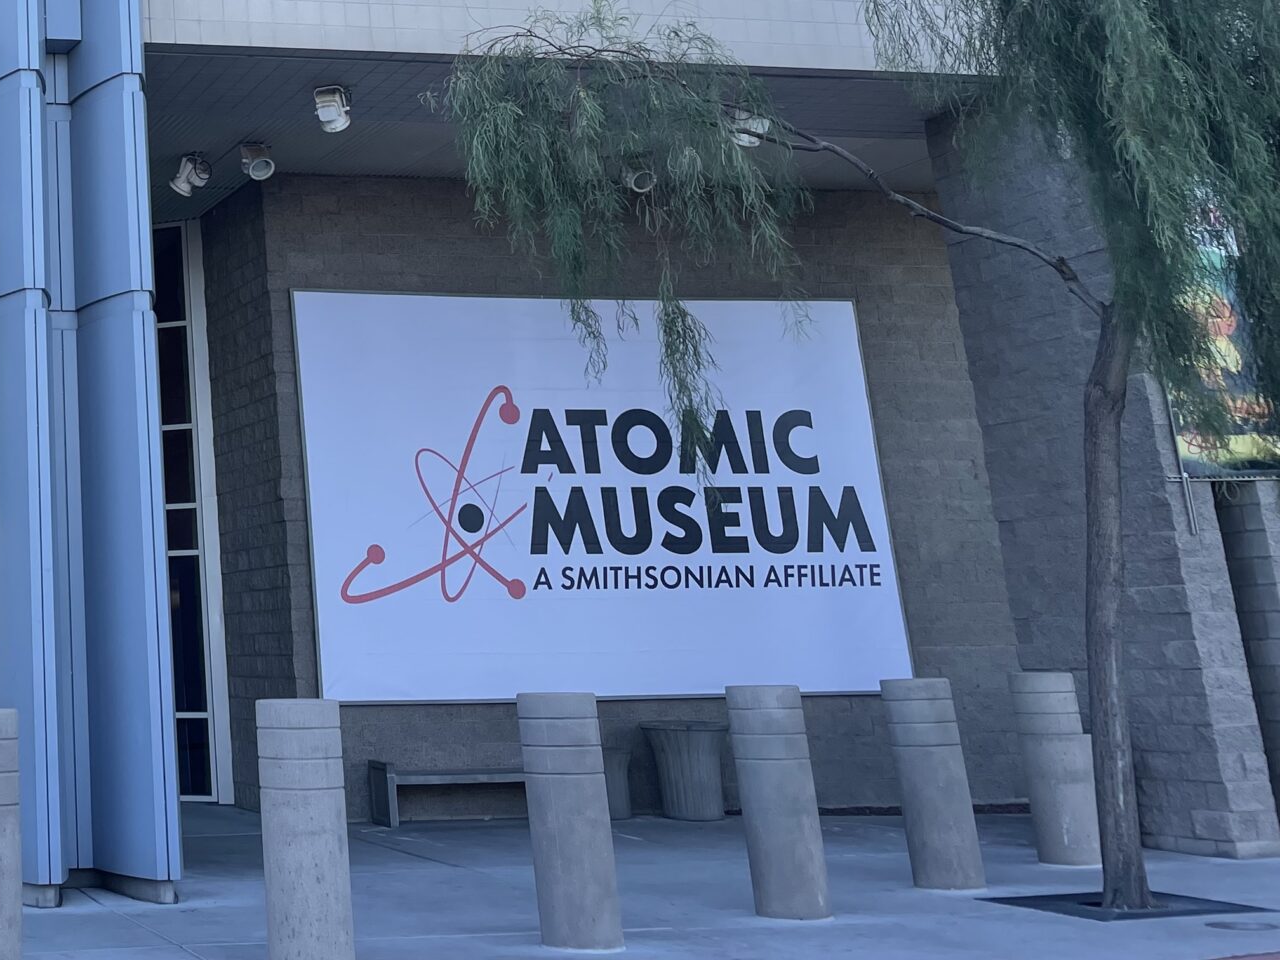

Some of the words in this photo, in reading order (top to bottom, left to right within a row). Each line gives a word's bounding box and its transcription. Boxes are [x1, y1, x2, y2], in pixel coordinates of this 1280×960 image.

[520, 408, 821, 475] ATOMIC
[530, 485, 877, 555] MUSEUM
[533, 567, 553, 590] A
[561, 565, 755, 591] SMITHSONIAN
[763, 563, 882, 588] AFFILIATE
